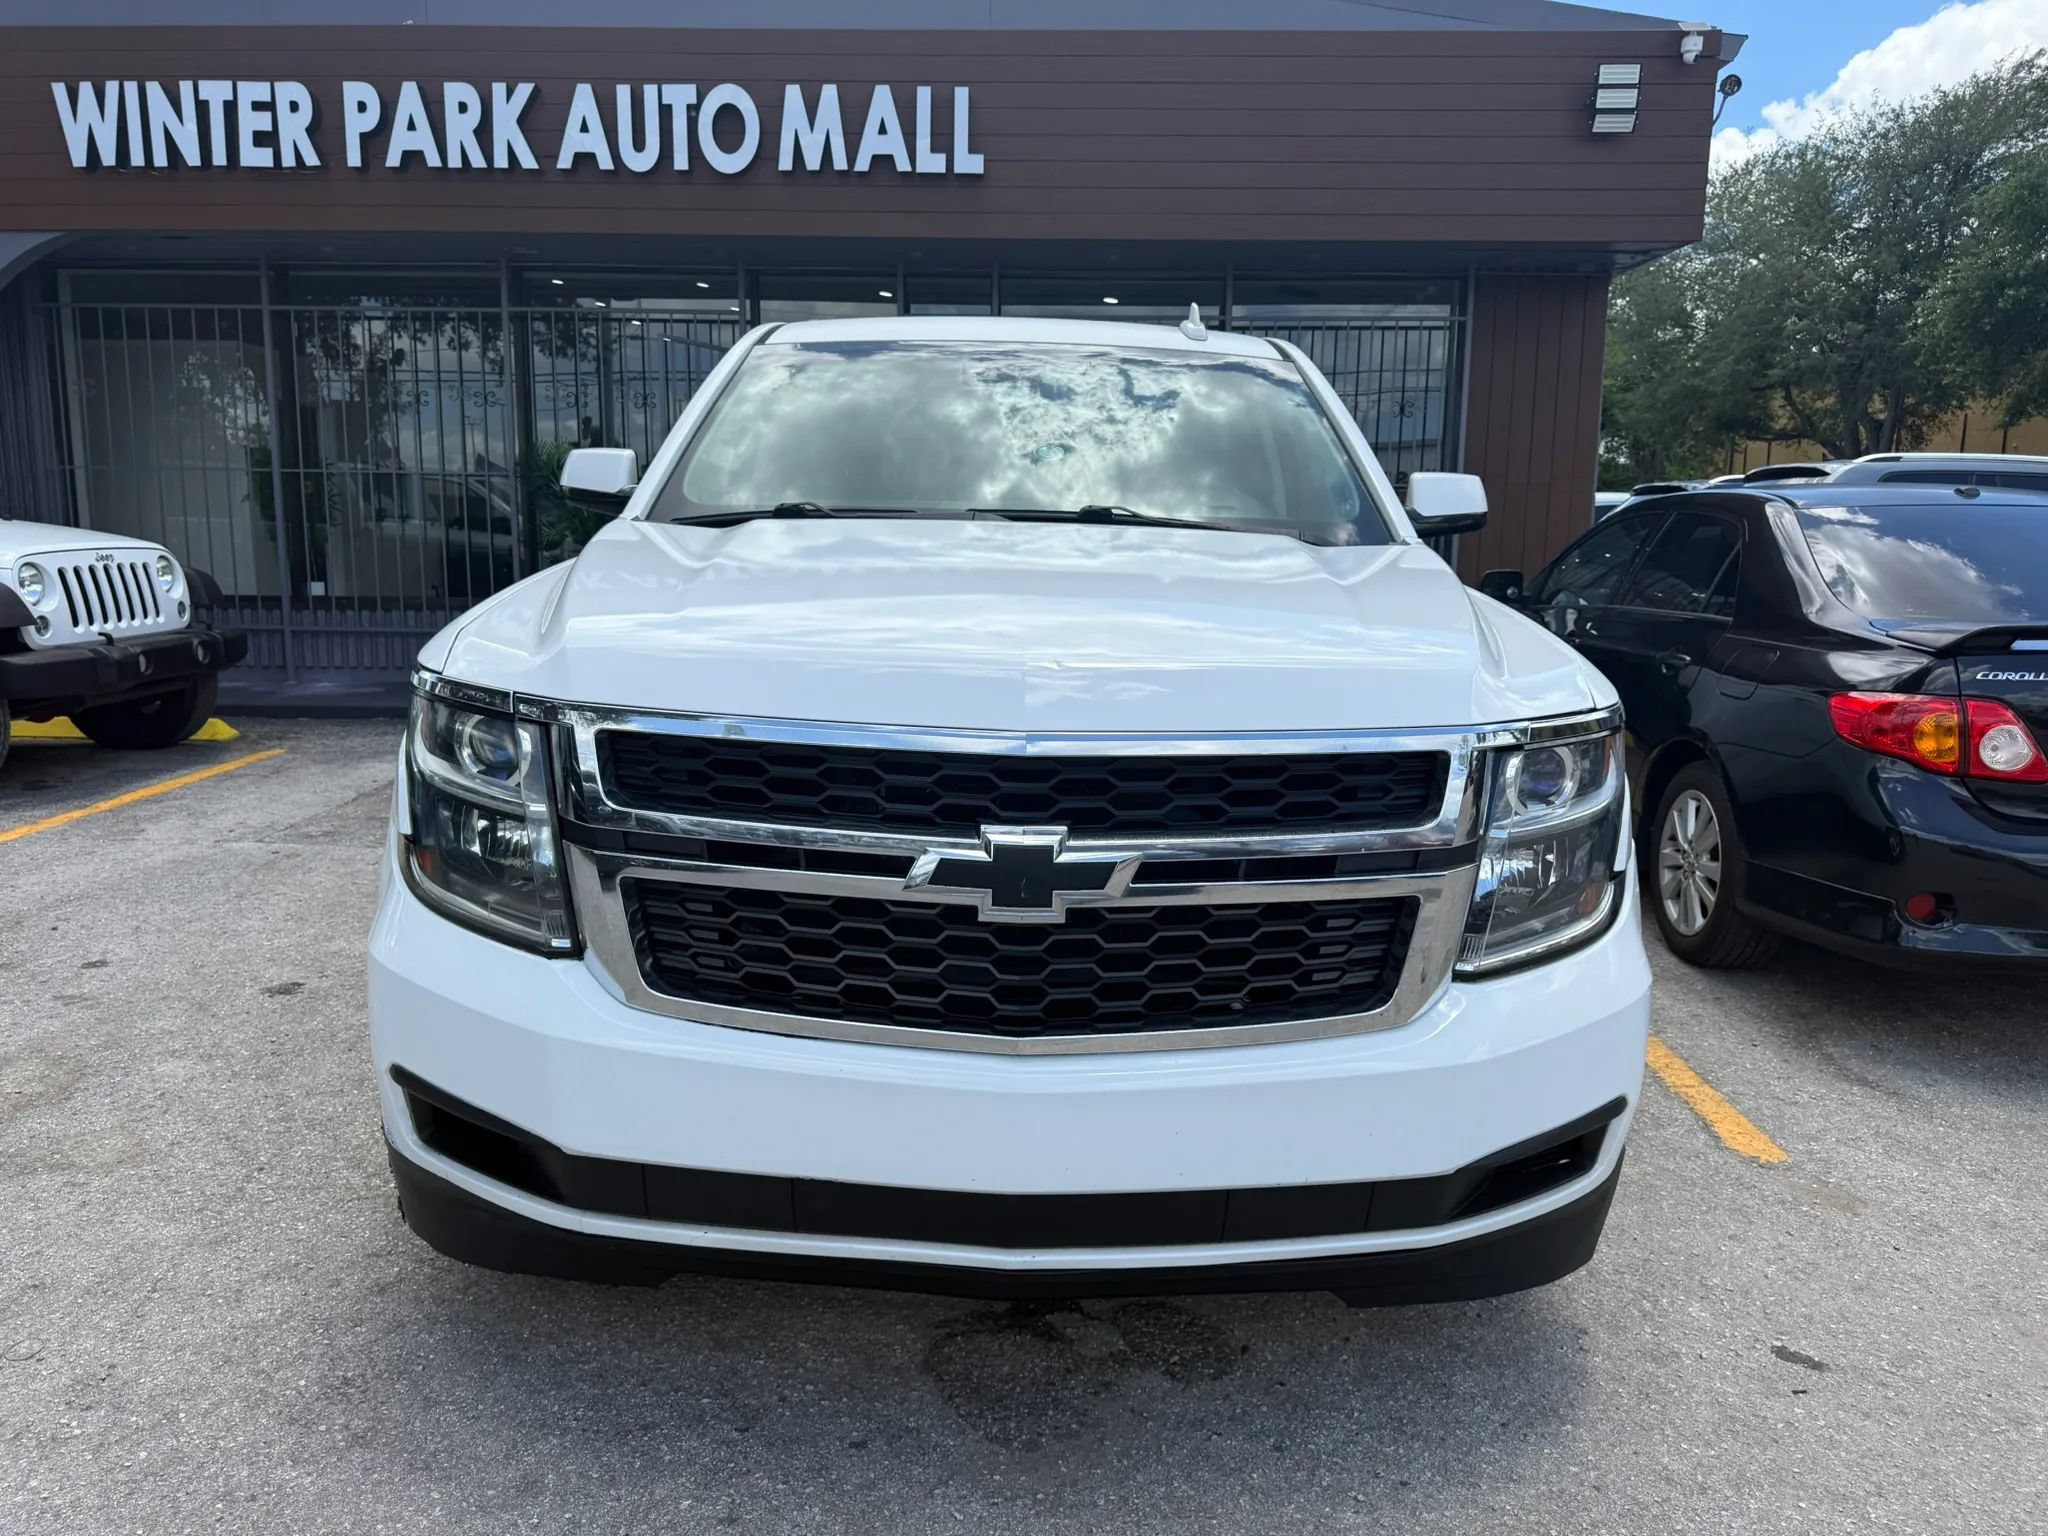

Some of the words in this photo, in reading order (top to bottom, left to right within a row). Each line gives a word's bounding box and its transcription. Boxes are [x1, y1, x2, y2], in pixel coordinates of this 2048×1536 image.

[51, 80, 321, 169] WINTER
[342, 81, 540, 170] PARK
[556, 83, 760, 175] AUTO
[778, 84, 985, 175] MALL
[95, 551, 115, 563] Jeep
